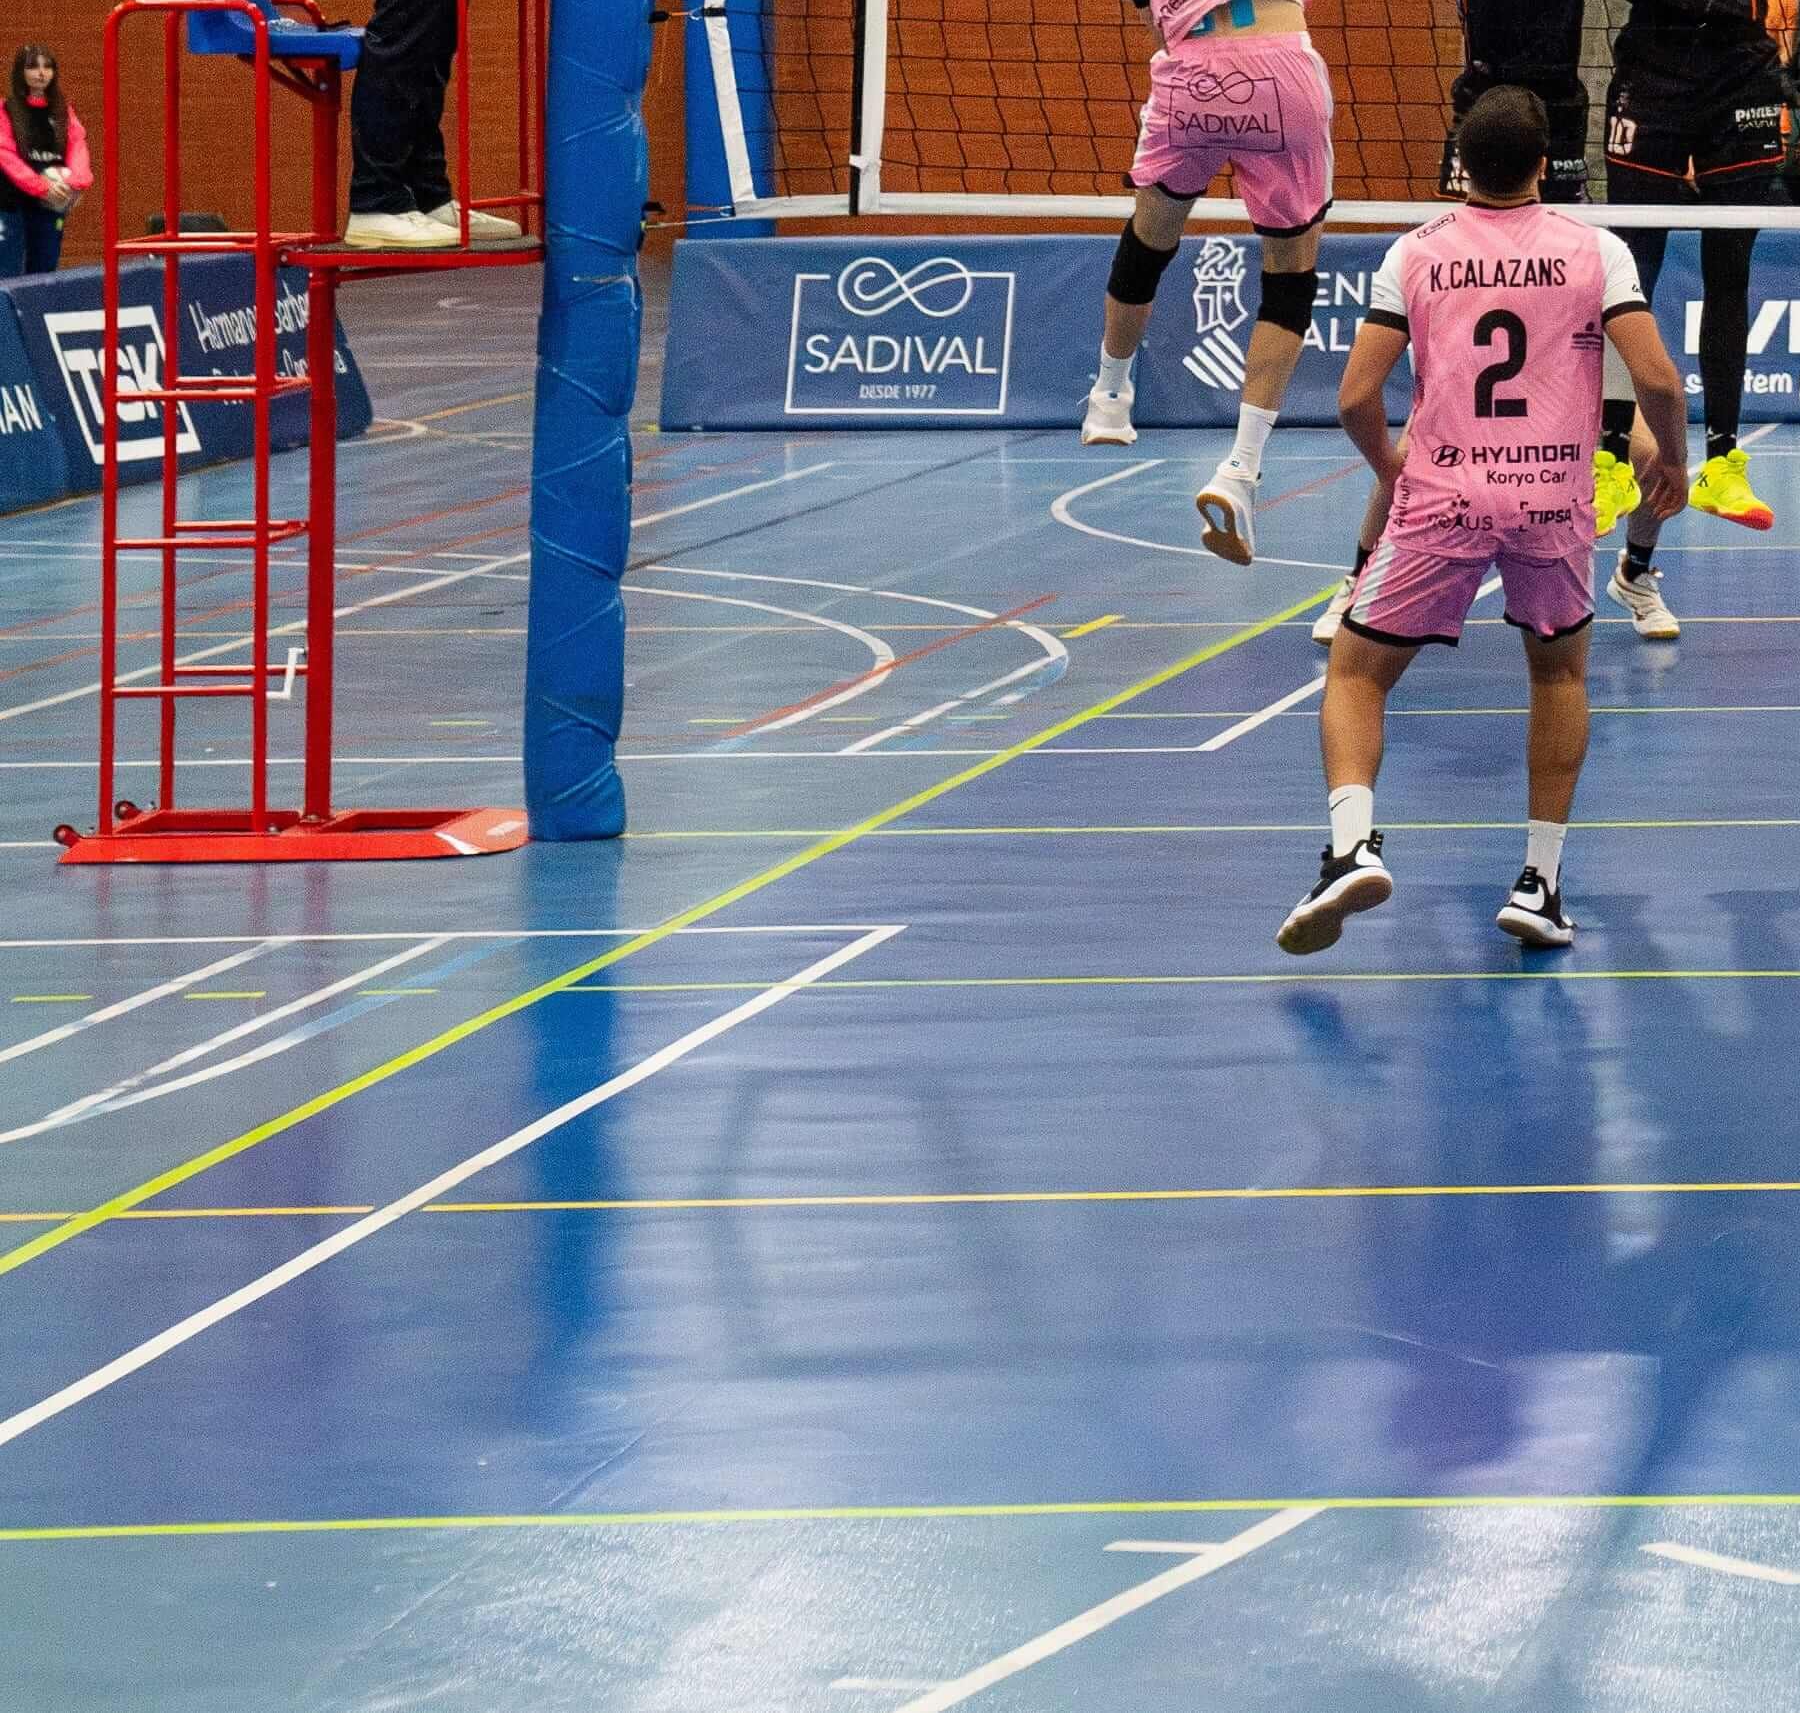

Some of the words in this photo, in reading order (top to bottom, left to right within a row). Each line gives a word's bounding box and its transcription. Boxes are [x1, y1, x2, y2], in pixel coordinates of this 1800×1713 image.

[1174, 110, 1278, 135] SADIVAL
[1430, 258, 1567, 292] K.CALAZANS
[804, 334, 998, 375] SADIVAL
[1473, 308, 1528, 418] 2
[860, 384, 900, 400] DESDE
[905, 383, 936, 399] 1977
[1471, 444, 1580, 464] HYUNDAI
[1487, 470, 1535, 488] Koryo
[1540, 469, 1567, 485] Car
